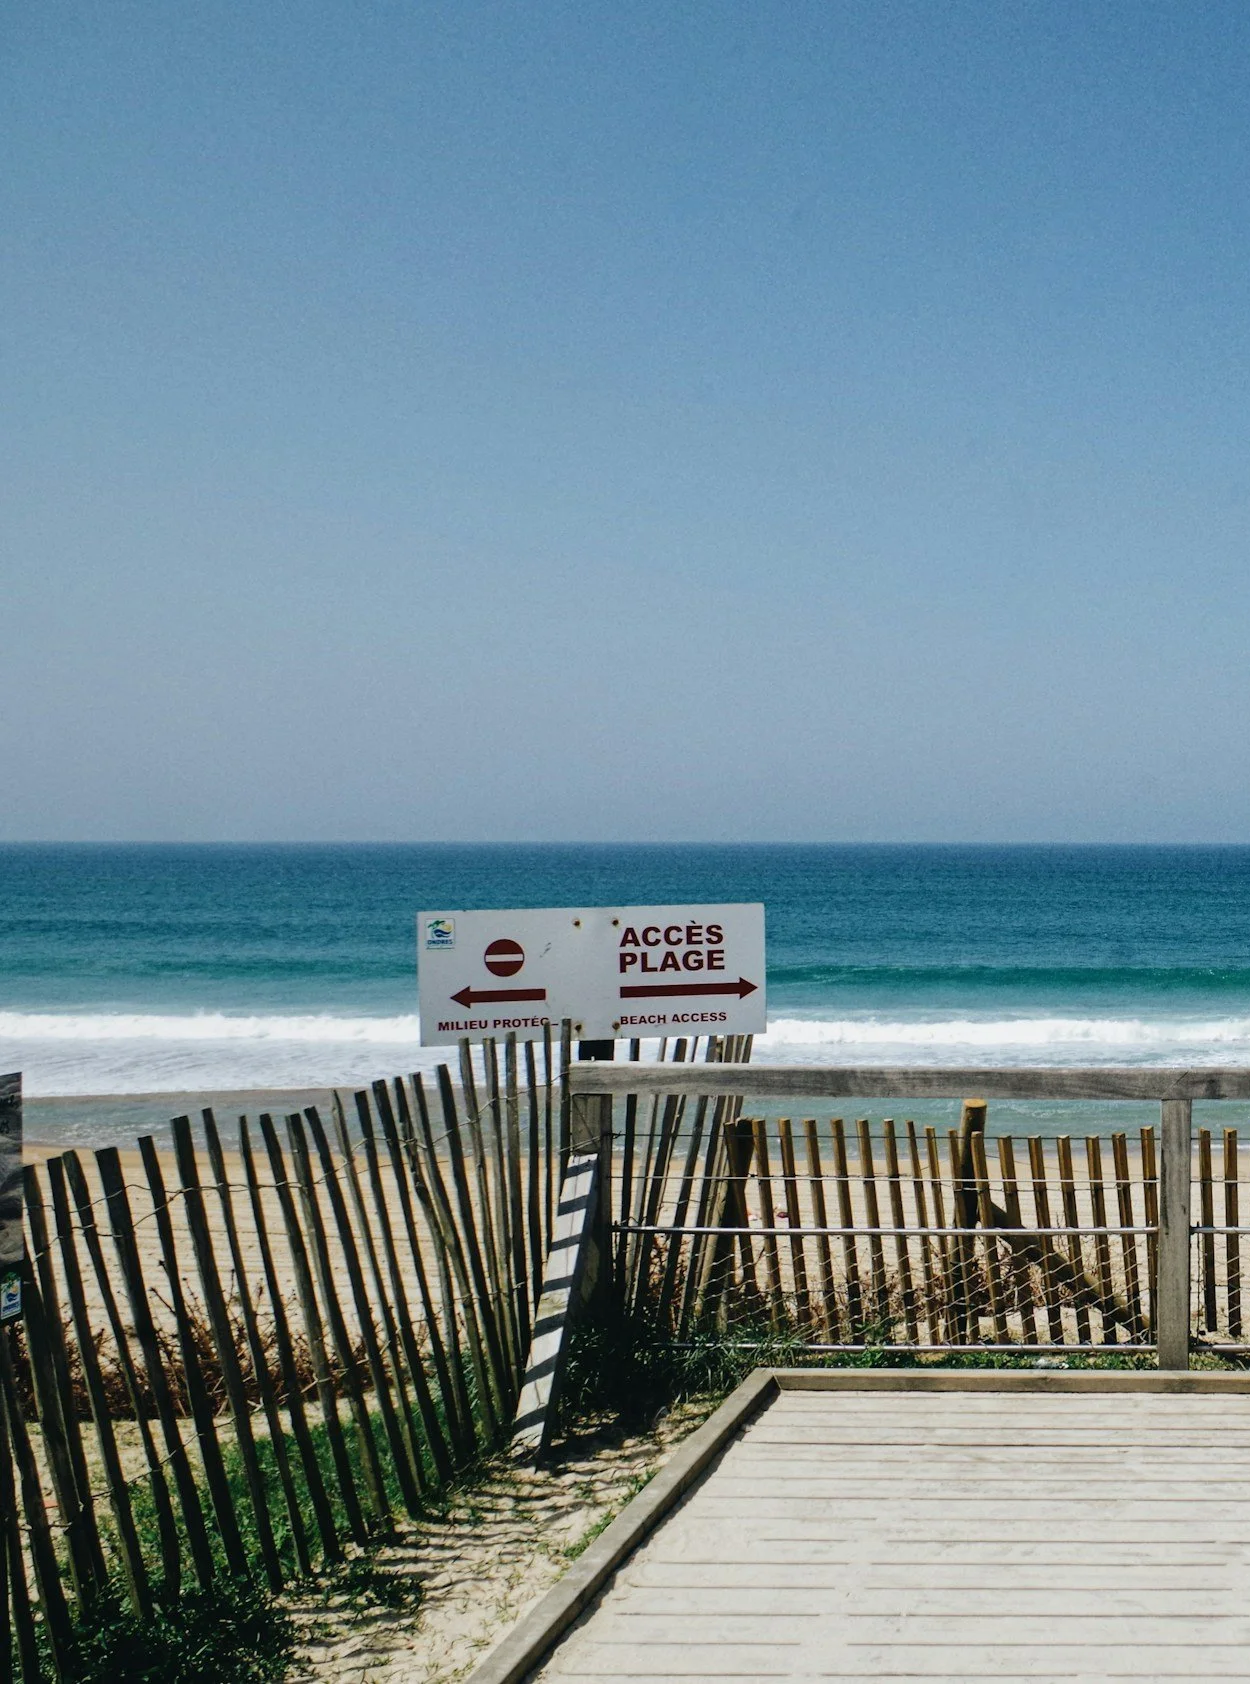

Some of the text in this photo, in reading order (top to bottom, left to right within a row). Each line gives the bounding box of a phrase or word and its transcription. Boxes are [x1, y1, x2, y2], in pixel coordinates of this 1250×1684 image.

[619, 919, 724, 947] ACCÈS
[619, 949, 726, 973] PLAGE
[438, 1015, 559, 1032] MILIEU PROTÉ
[619, 1011, 728, 1026] BEACH ACCESS
